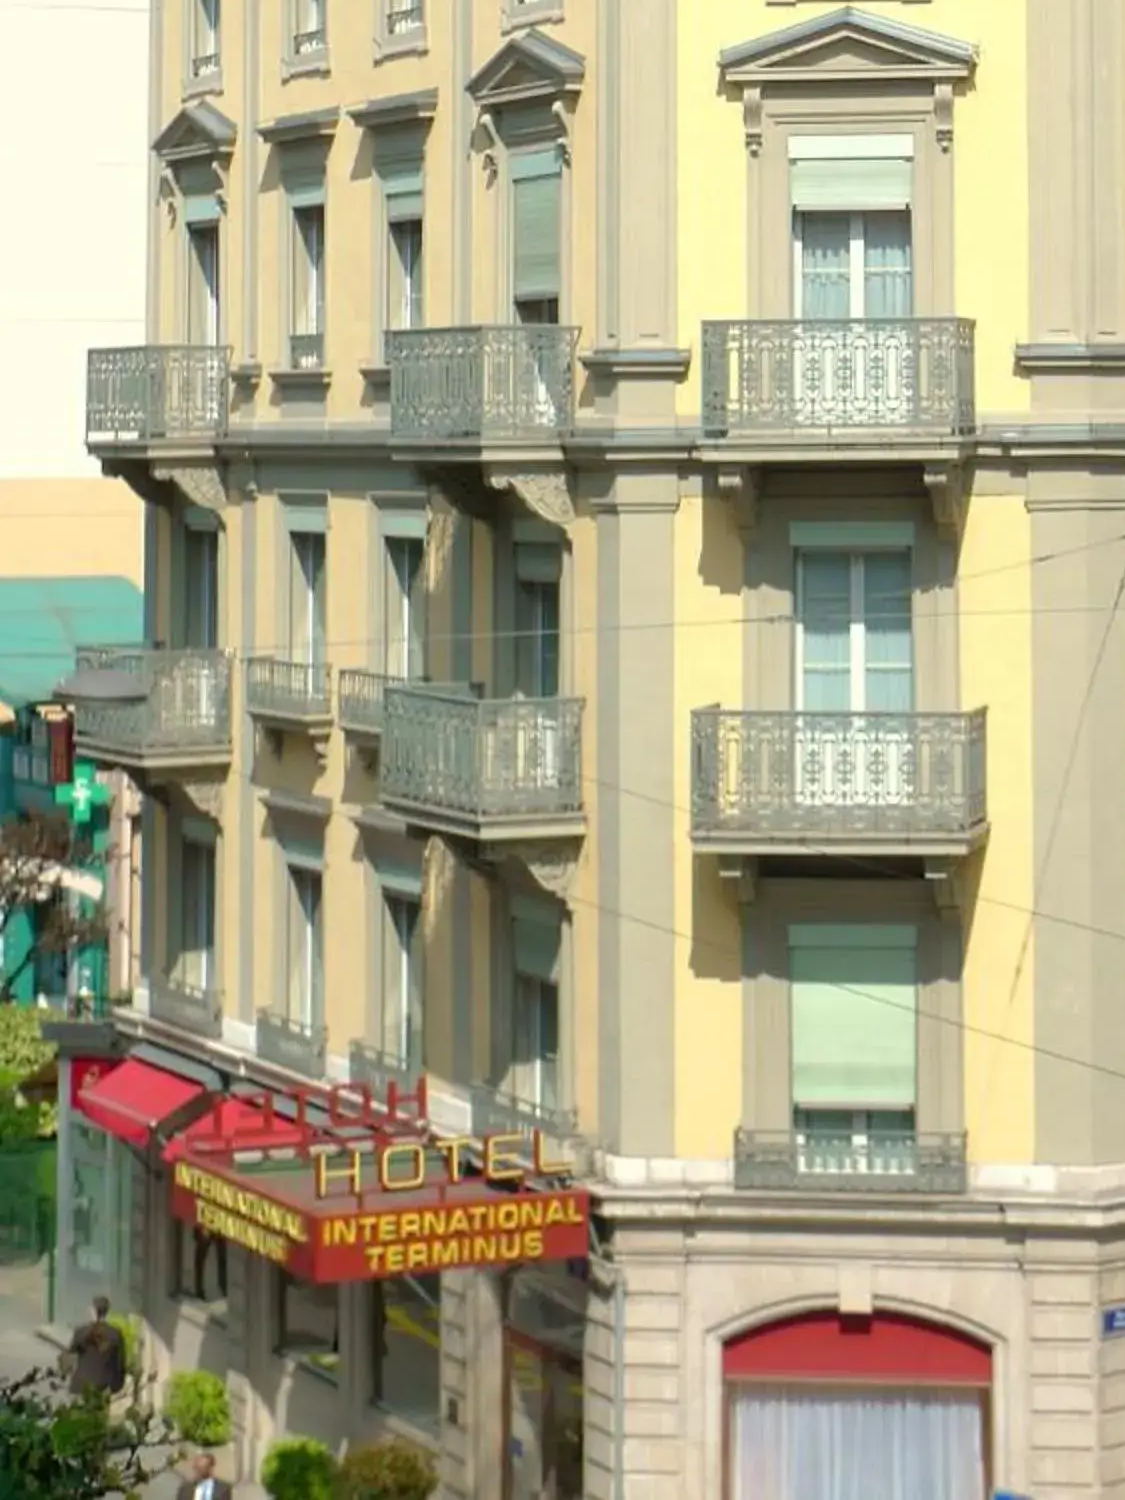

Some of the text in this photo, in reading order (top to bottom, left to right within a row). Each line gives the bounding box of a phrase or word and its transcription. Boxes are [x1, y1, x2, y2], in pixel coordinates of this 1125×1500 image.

[316, 1129, 573, 1198] HOTEL
[175, 1161, 308, 1242] INTERNATIONAL
[196, 1199, 288, 1261] TERMINUS
[322, 1198, 583, 1246] INTERNATIONAL
[366, 1231, 544, 1272] TERMINUS
